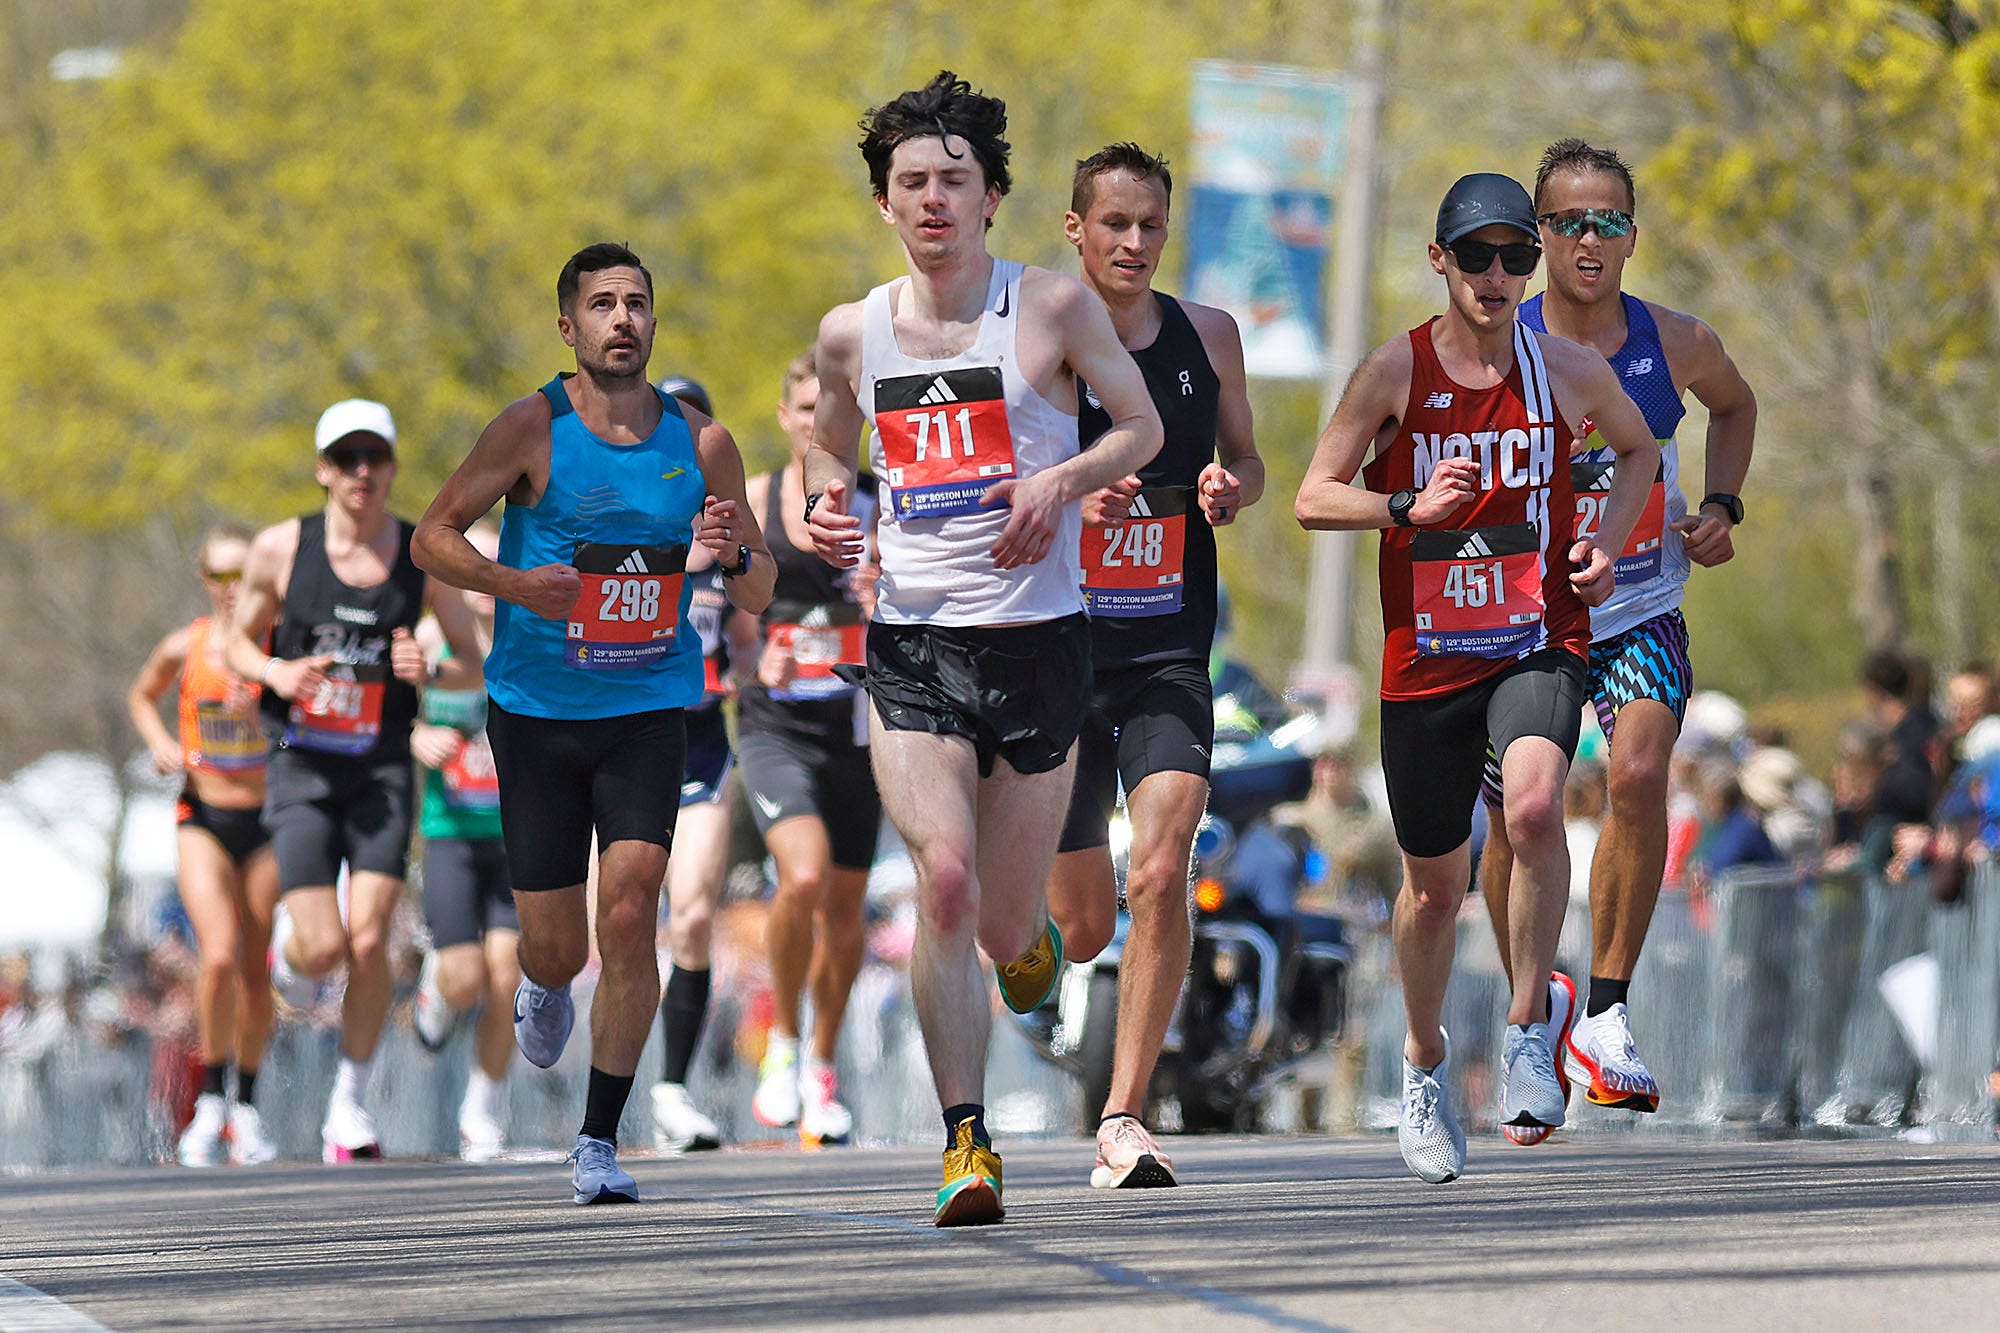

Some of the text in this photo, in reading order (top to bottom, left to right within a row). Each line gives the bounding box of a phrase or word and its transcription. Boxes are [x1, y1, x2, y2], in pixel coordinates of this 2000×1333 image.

[906, 408, 975, 461] 711
[930, 491, 961, 502] BOSTON
[941, 500, 968, 508] AMERICA
[1102, 523, 1163, 566] 248
[1620, 559, 1654, 571] MARATHON
[1443, 562, 1504, 608] 451
[599, 579, 661, 622] 298
[1112, 596, 1140, 604] BOSTON
[1141, 592, 1173, 603] MARATHON
[1462, 637, 1491, 646] BOSTON
[609, 649, 634, 658] BOSTON
[635, 645, 667, 656] MARATHON
